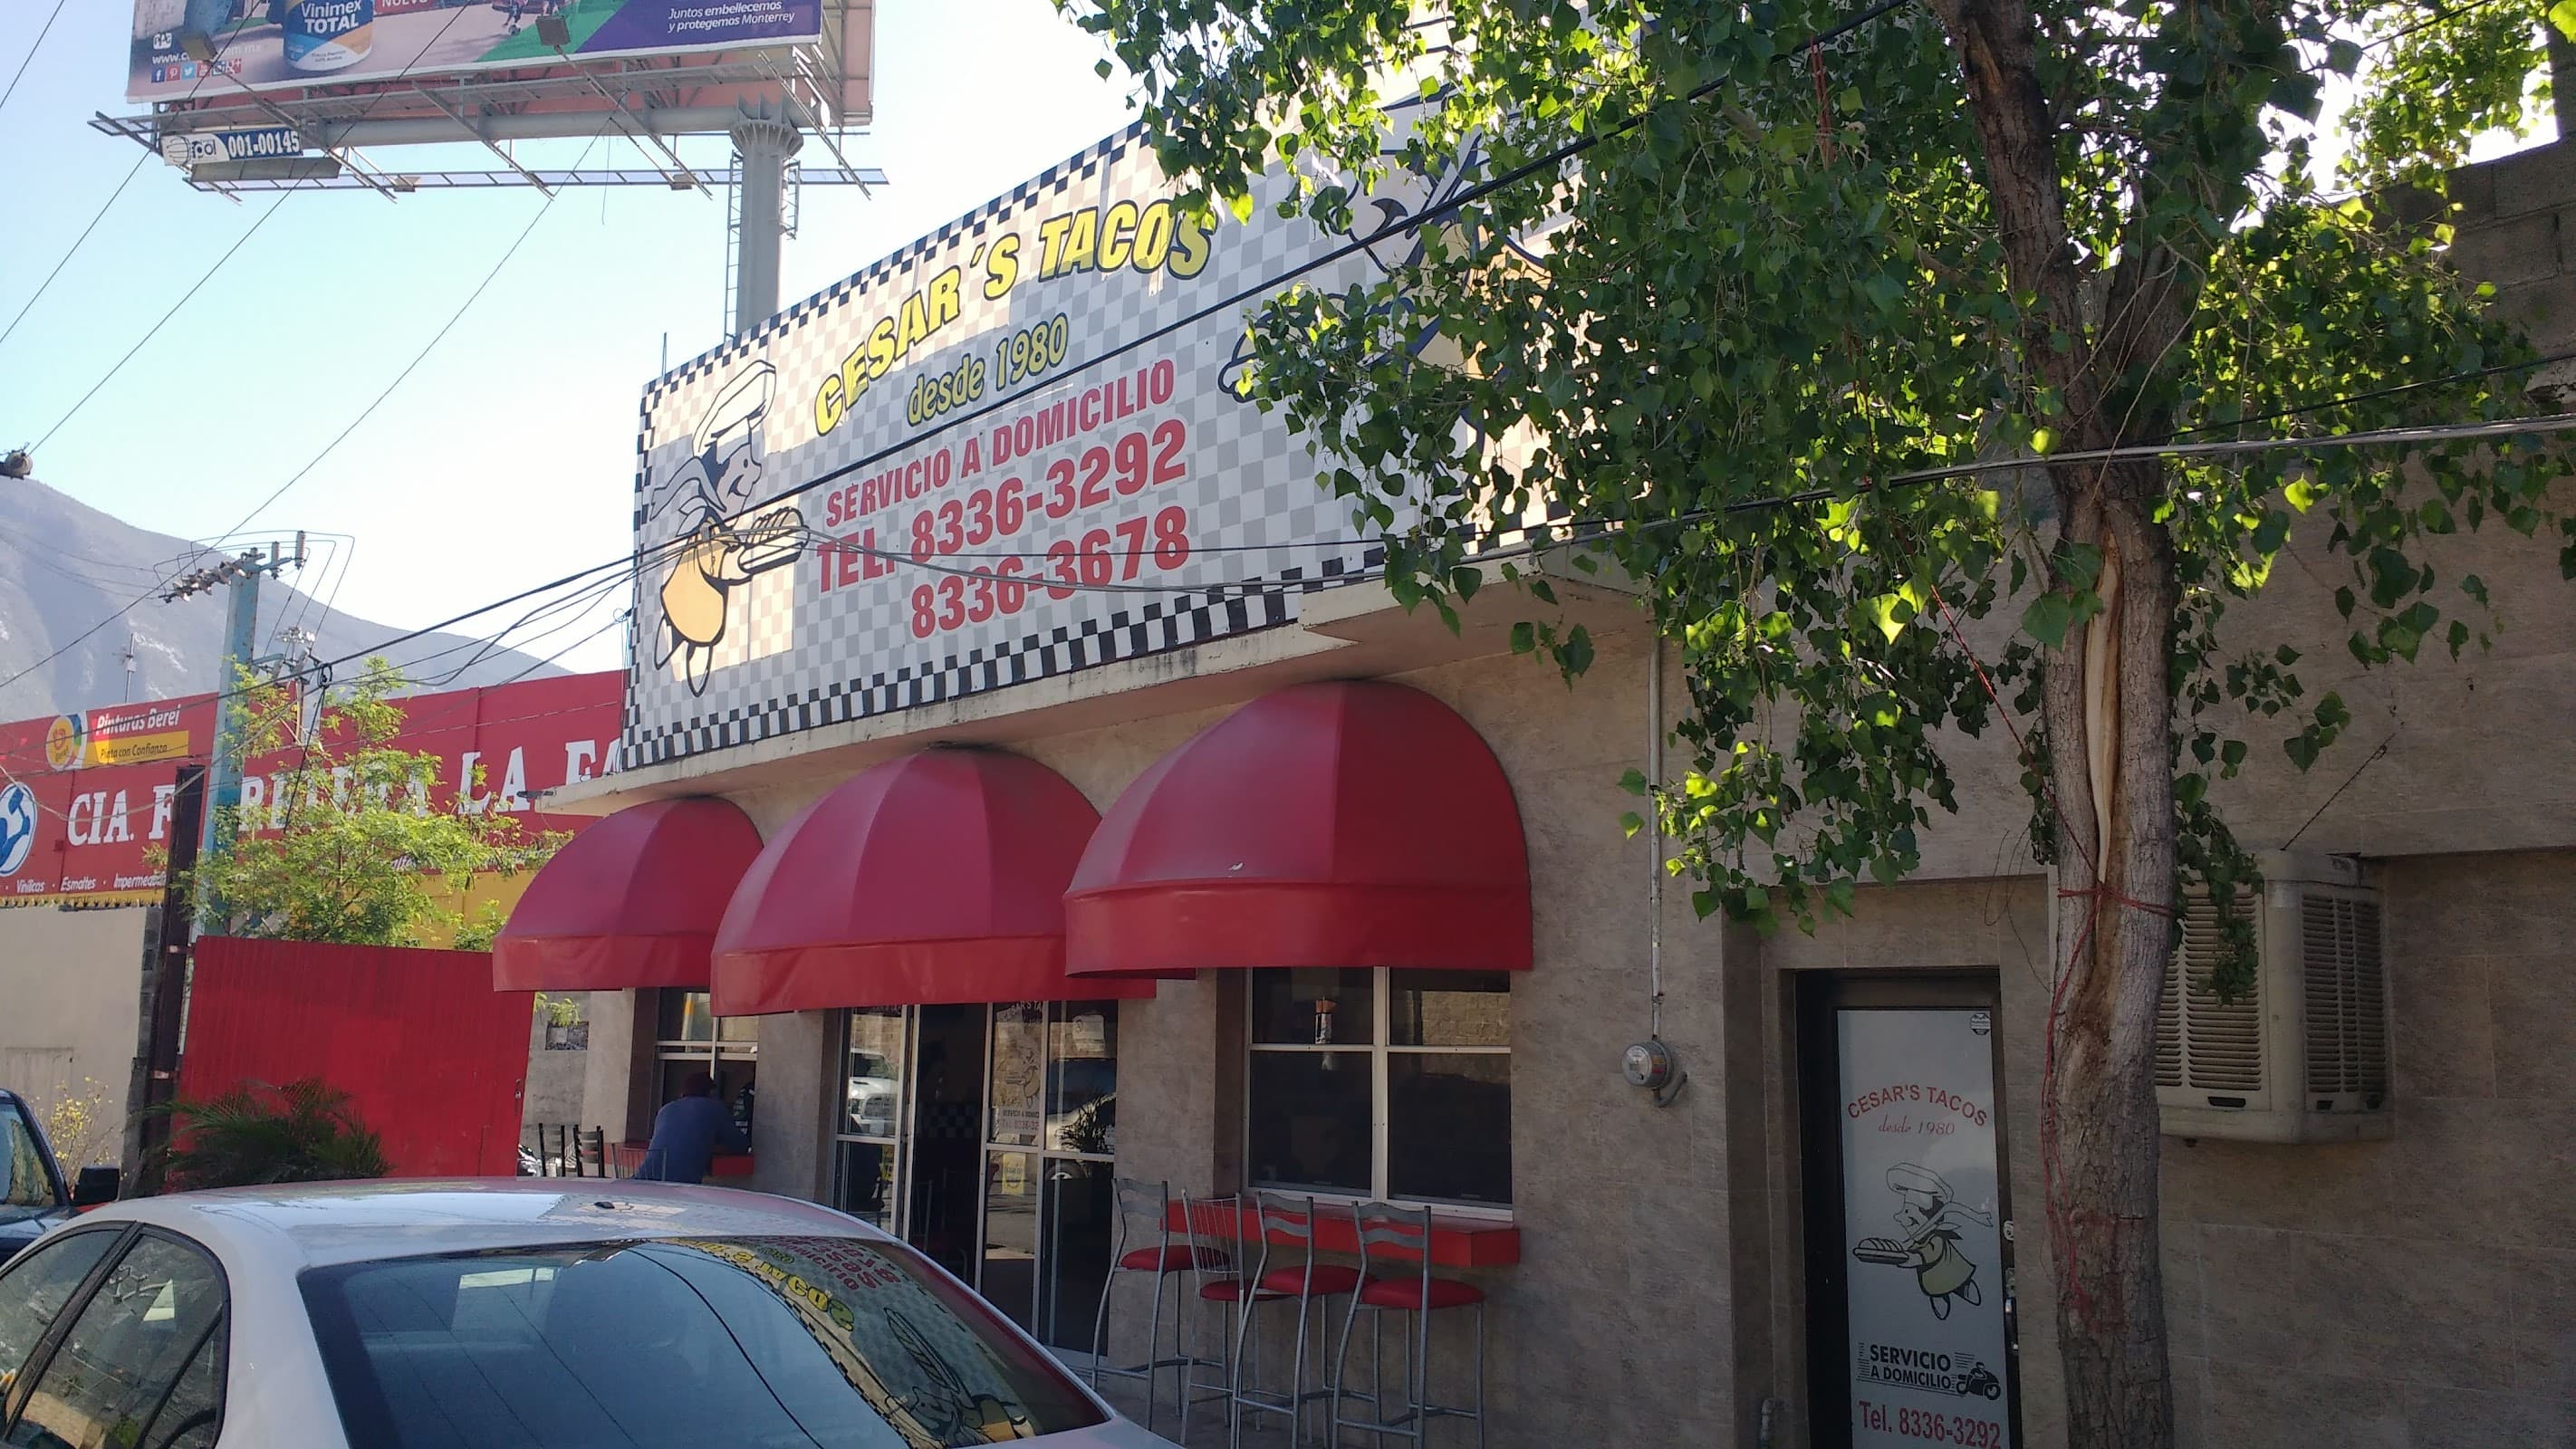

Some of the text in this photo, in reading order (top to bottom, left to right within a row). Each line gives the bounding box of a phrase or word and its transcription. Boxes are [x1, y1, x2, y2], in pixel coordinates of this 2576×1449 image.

[302, 0, 361, 17] Vinimex
[668, 1, 782, 21] Juntos embellecemos
[668, 12, 795, 33] y protegemos Monterrey
[304, 15, 360, 34] TOTAL
[228, 130, 300, 158] 001-00145
[1037, 198, 1217, 282] TACOS
[907, 312, 1069, 428] desde 1980
[825, 358, 1176, 528] SERVICIO A DOMICILIO
[911, 418, 1187, 564] 8336-3292
[911, 505, 1190, 639] 8336-3678
[95, 704, 181, 735] Pinturas Berel
[119, 745, 131, 757] con
[132, 742, 168, 757] Confianza
[67, 789, 135, 846] CIA.
[457, 745, 530, 814] LA
[61, 876, 97, 891] Esmaltes
[1848, 1084, 1988, 1127] CESAR'S TACOS
[1879, 1113, 1956, 1136] desde 1980
[1870, 1344, 1951, 1372] SERVICIO
[1870, 1365, 1951, 1389] A DOMICILIO
[1859, 1400, 2001, 1449] Tel. 8336-3292
